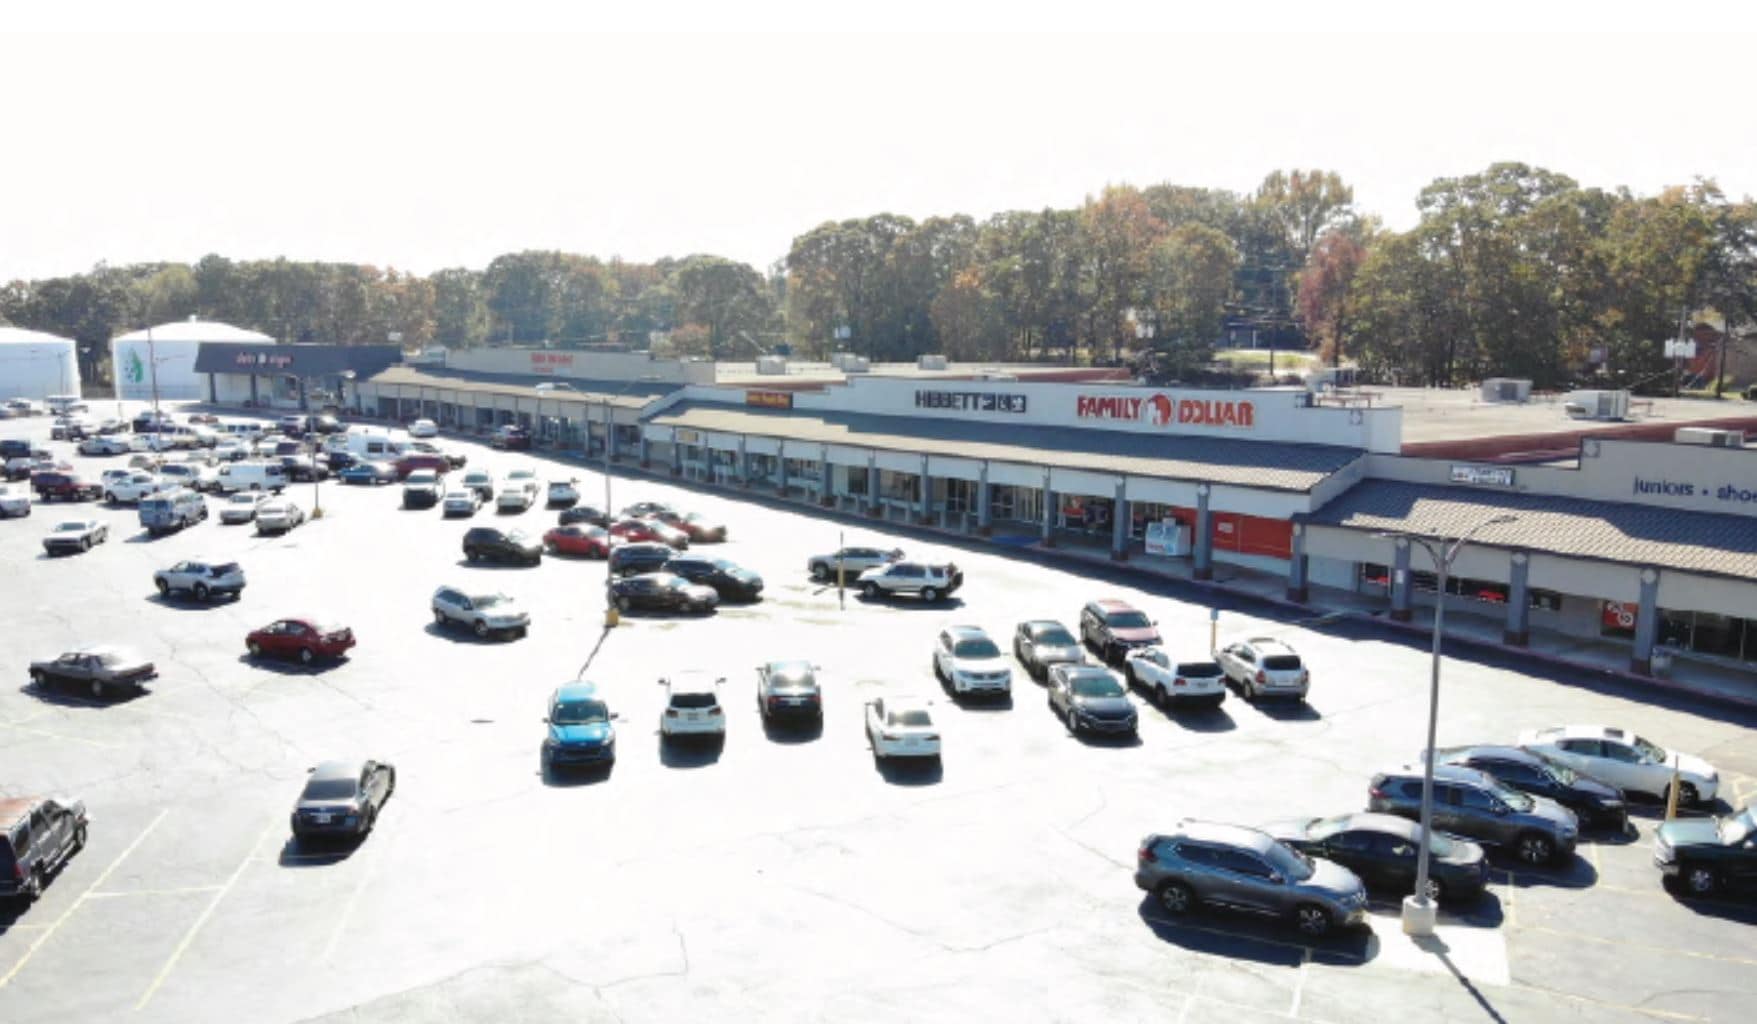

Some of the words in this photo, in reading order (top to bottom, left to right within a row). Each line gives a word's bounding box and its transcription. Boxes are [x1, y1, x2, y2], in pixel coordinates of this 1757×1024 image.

[915, 390, 982, 413] HIBBETT
[1077, 395, 1144, 420] FAMILY
[1178, 399, 1255, 427] DOLLAR
[1633, 475, 1695, 497] juniors
